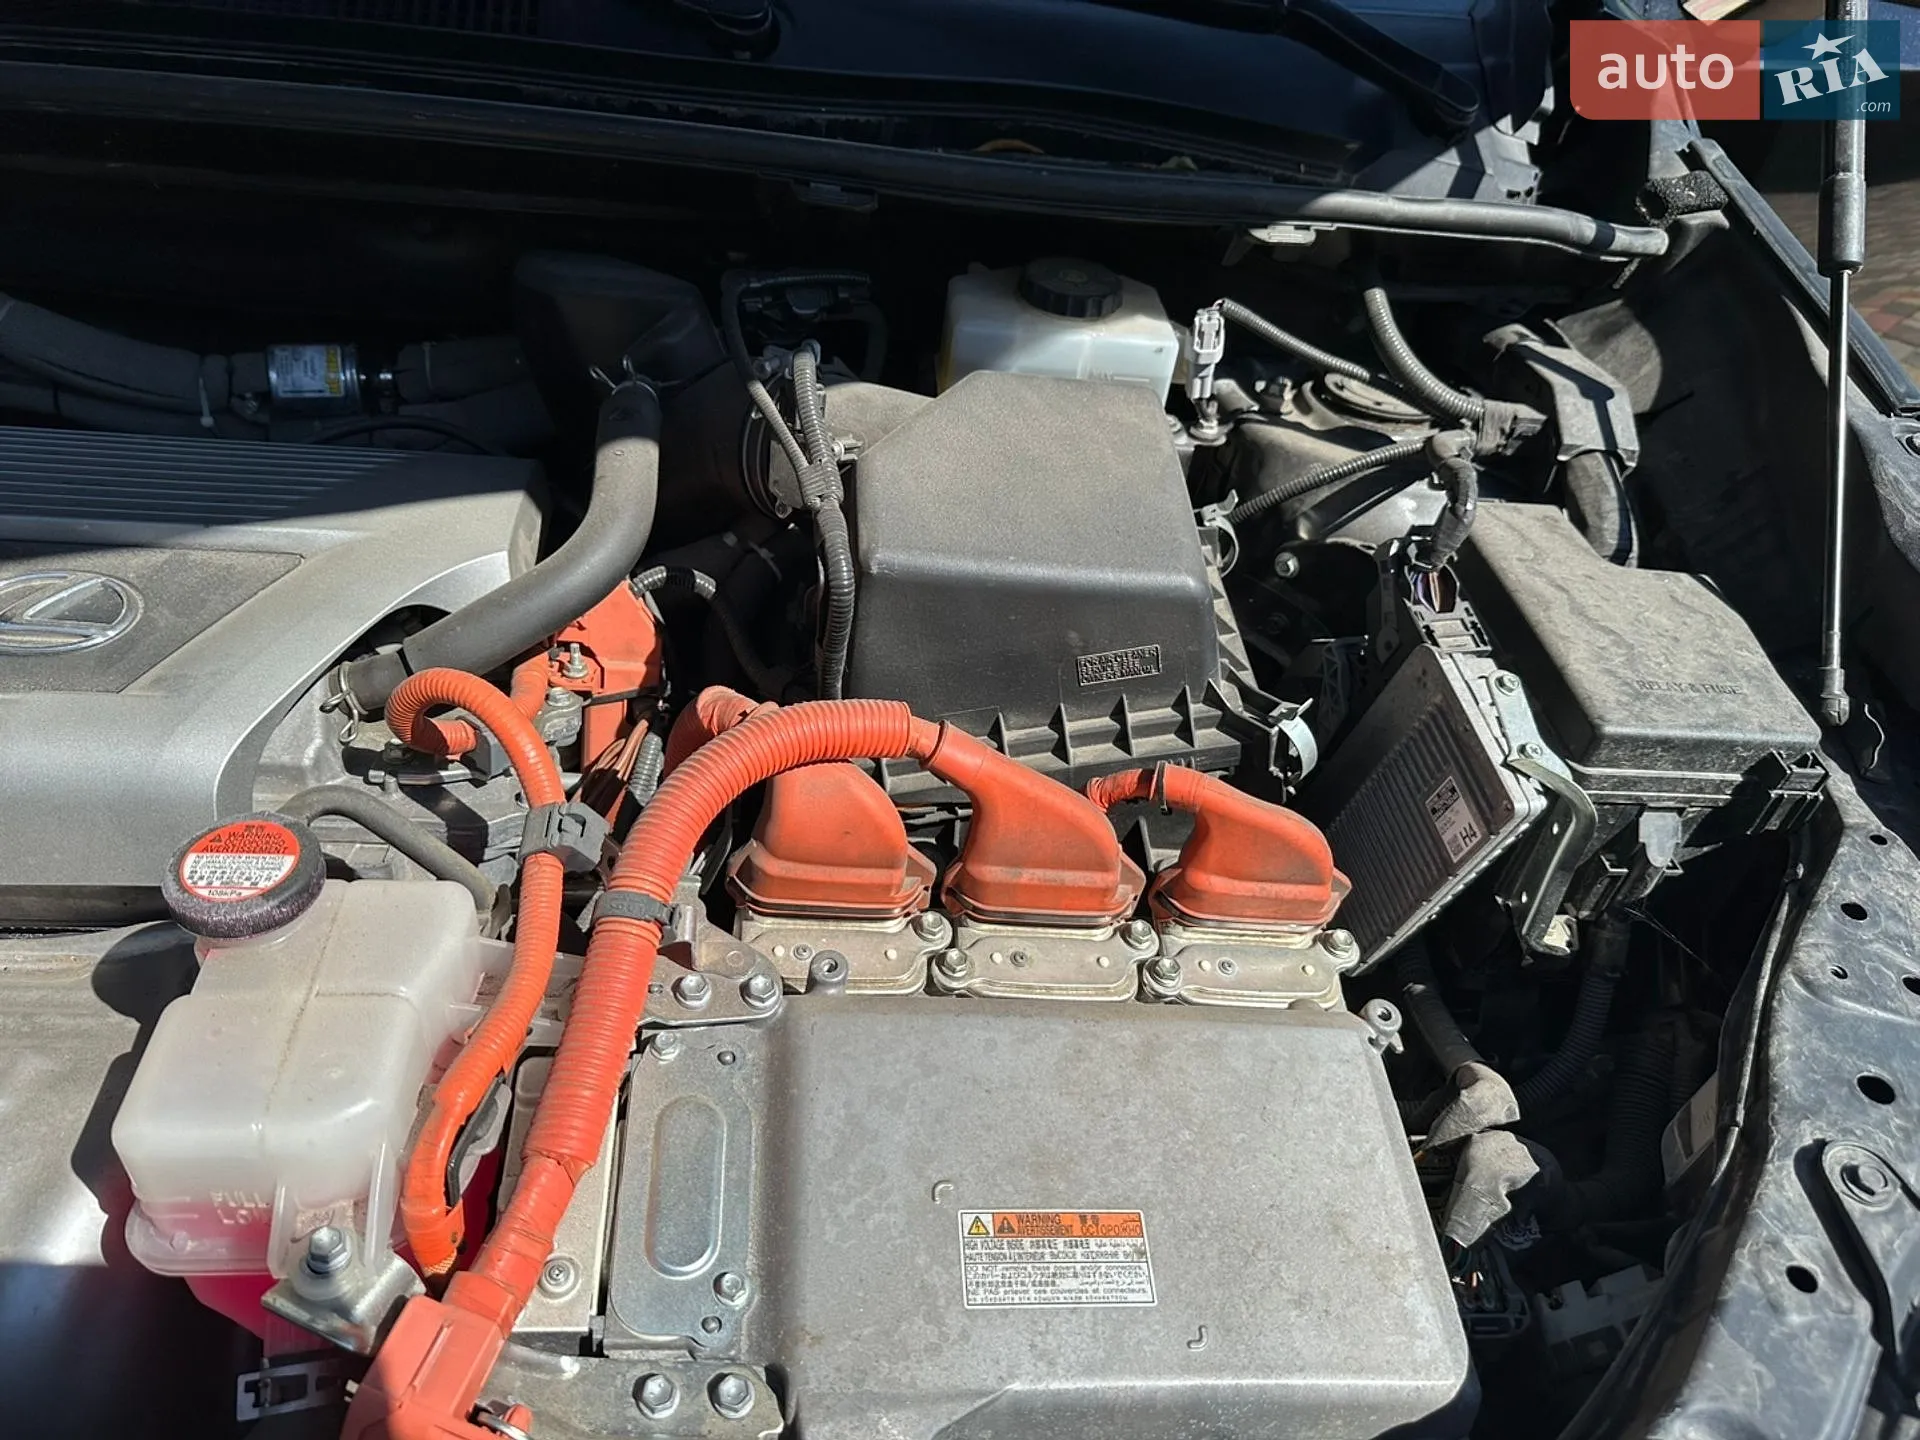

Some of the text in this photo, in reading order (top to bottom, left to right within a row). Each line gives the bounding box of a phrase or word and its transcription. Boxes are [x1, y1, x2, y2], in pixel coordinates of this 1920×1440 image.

[1116, 648, 1156, 661] CLEANER
[1122, 664, 1158, 676] MANUAL
[1636, 680, 1684, 692] RELAY
[1702, 683, 1745, 695] FUSE
[227, 832, 282, 840] WARNING
[1460, 822, 1477, 847] H4
[201, 845, 288, 854] AVERTISSEMENT
[210, 1190, 271, 1208] FULL
[1017, 1214, 1061, 1224] WARNING
[1018, 1225, 1073, 1236] AVERTISSEMENT
[1081, 1224, 1141, 1236] ОСТОРОЖНО
[965, 1239, 1024, 1250] HIGH VOLTAGE INSIDE
